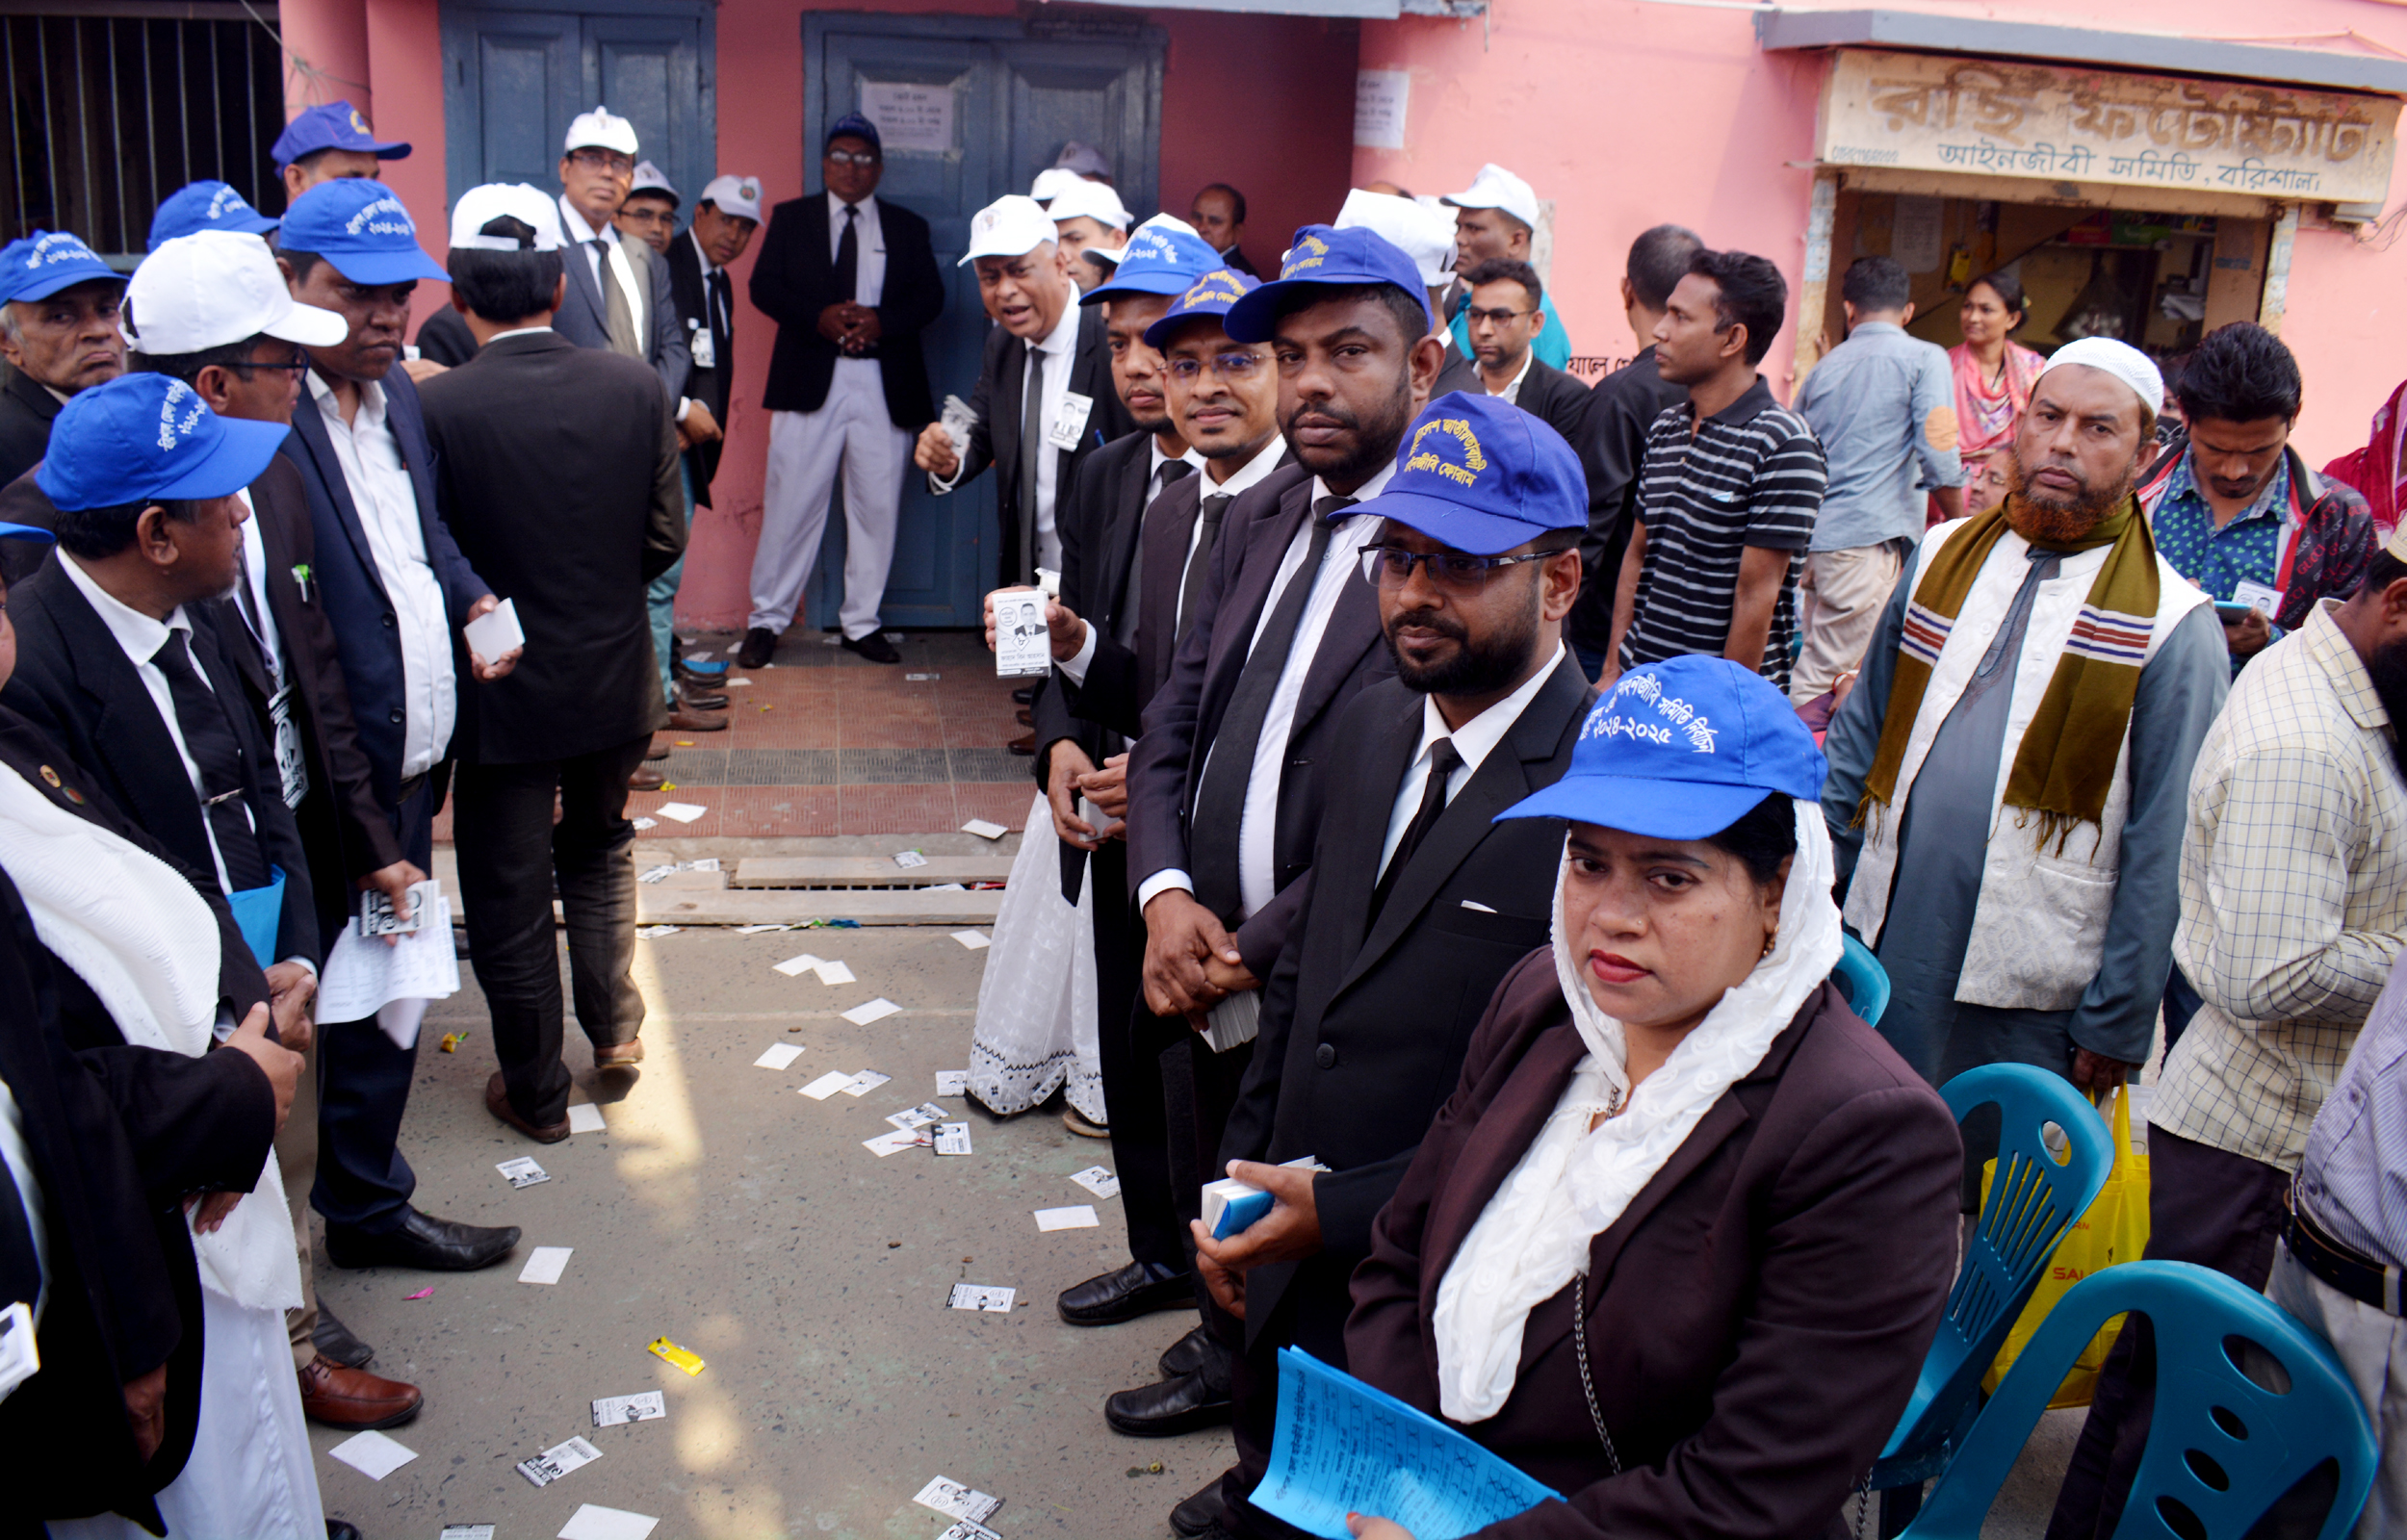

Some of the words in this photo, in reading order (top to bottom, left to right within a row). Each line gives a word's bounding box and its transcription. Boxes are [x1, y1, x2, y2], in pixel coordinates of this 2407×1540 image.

[1938, 137, 2097, 174] আইনজীবী
[2296, 543, 2326, 576] GUCCI
[1658, 697, 1694, 725] সমিতি
[1681, 716, 1719, 754] নির্বাচন
